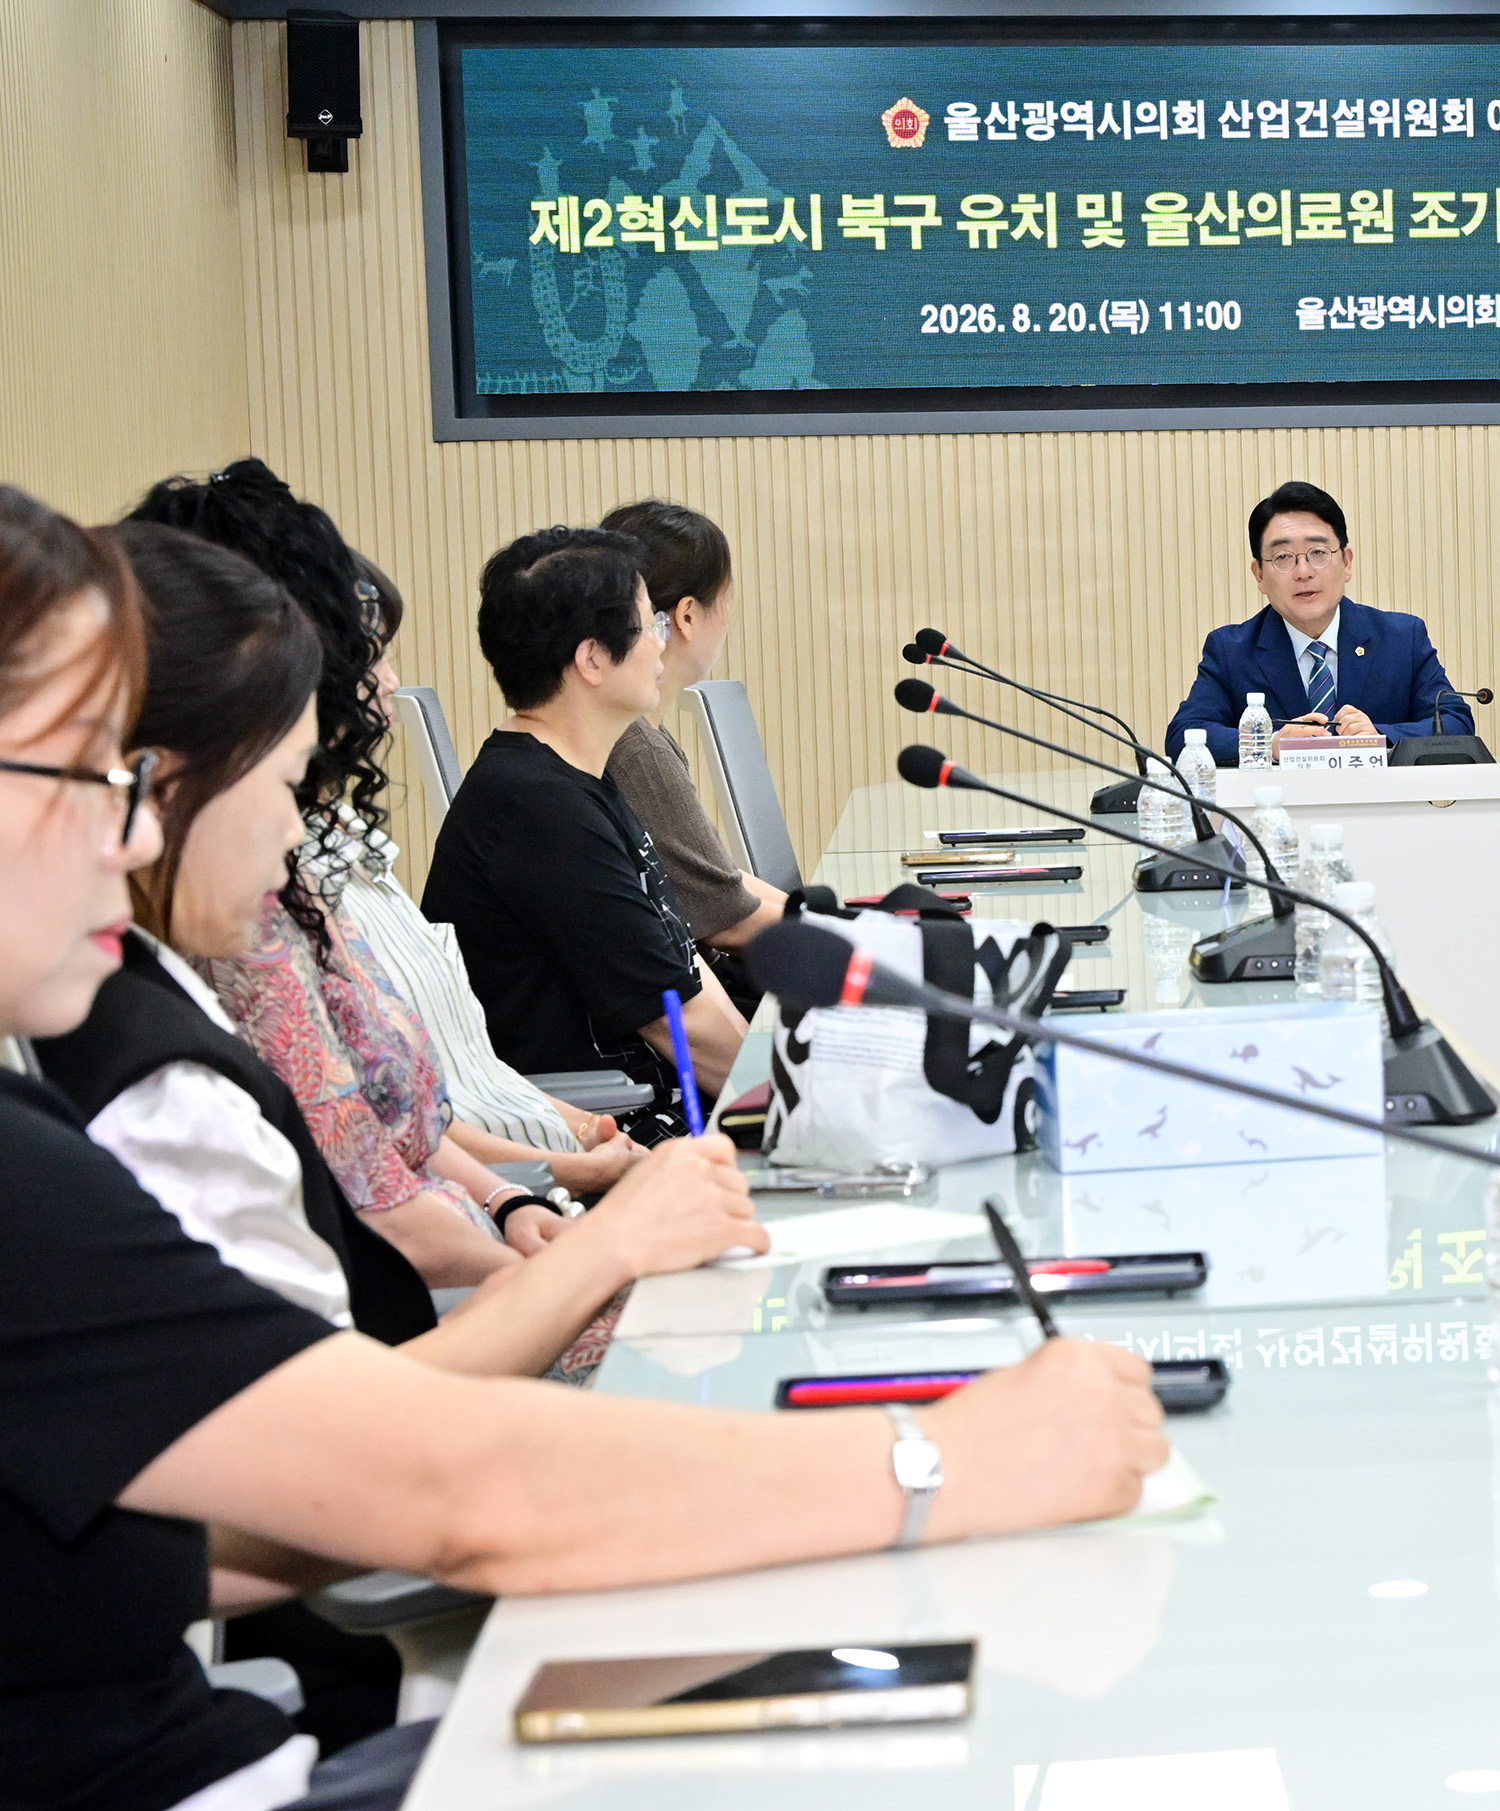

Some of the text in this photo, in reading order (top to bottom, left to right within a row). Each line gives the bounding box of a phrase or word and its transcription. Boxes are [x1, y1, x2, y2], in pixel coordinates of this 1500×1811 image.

[895, 117, 917, 131] 의회
[945, 100, 1206, 142] 울산광역시의회
[1219, 98, 1475, 140] 산업건설위원회
[530, 194, 824, 254] 제2혁신도시
[838, 195, 944, 251] 북구
[957, 192, 1059, 250] 유치
[1077, 192, 1127, 250] 및
[1142, 189, 1395, 248] 울산의료원
[1160, 301, 1243, 332] 11:00
